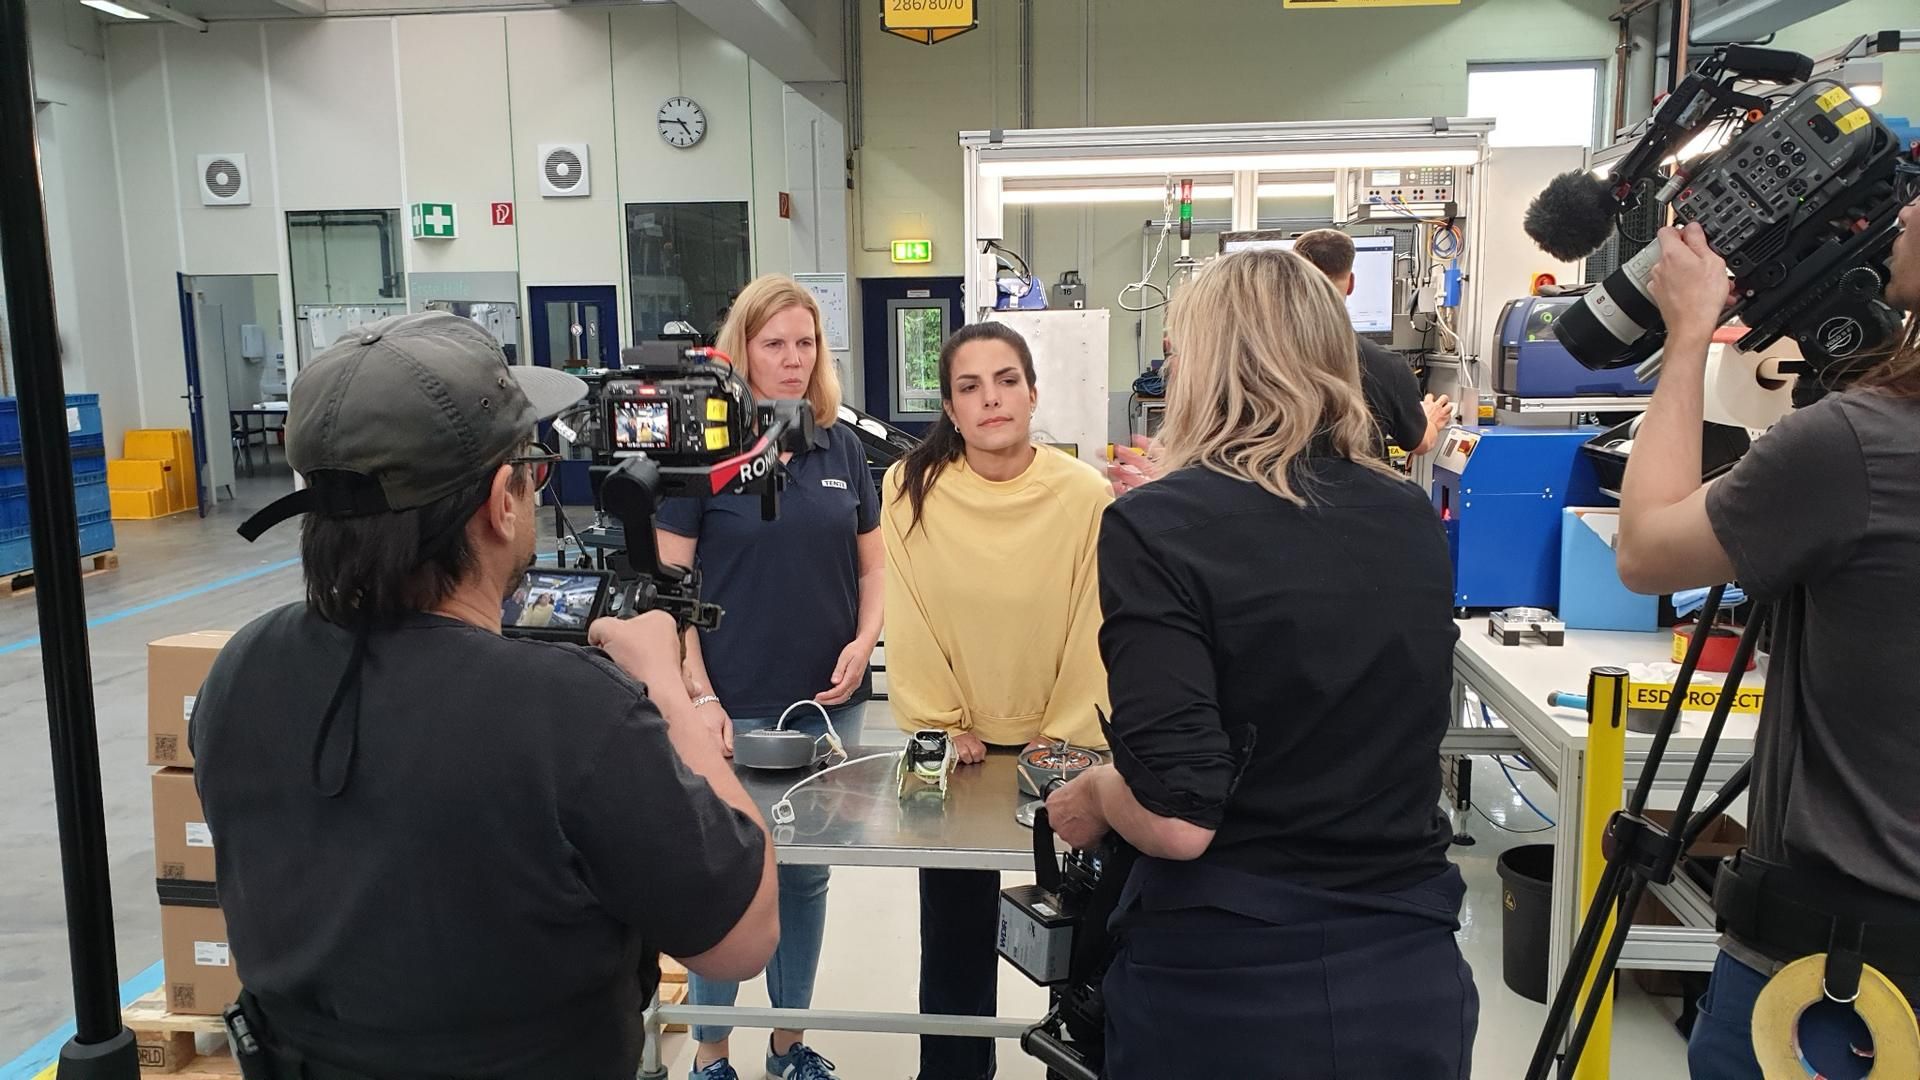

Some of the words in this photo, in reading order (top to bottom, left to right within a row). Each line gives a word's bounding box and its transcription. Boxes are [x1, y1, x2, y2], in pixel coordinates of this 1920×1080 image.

[1764, 100, 1797, 128] SONY
[740, 440, 778, 483] RONIN
[1637, 688, 1673, 704] ESD
[1684, 691, 1764, 709] ROCT
[139, 1049, 161, 1064] RLD
